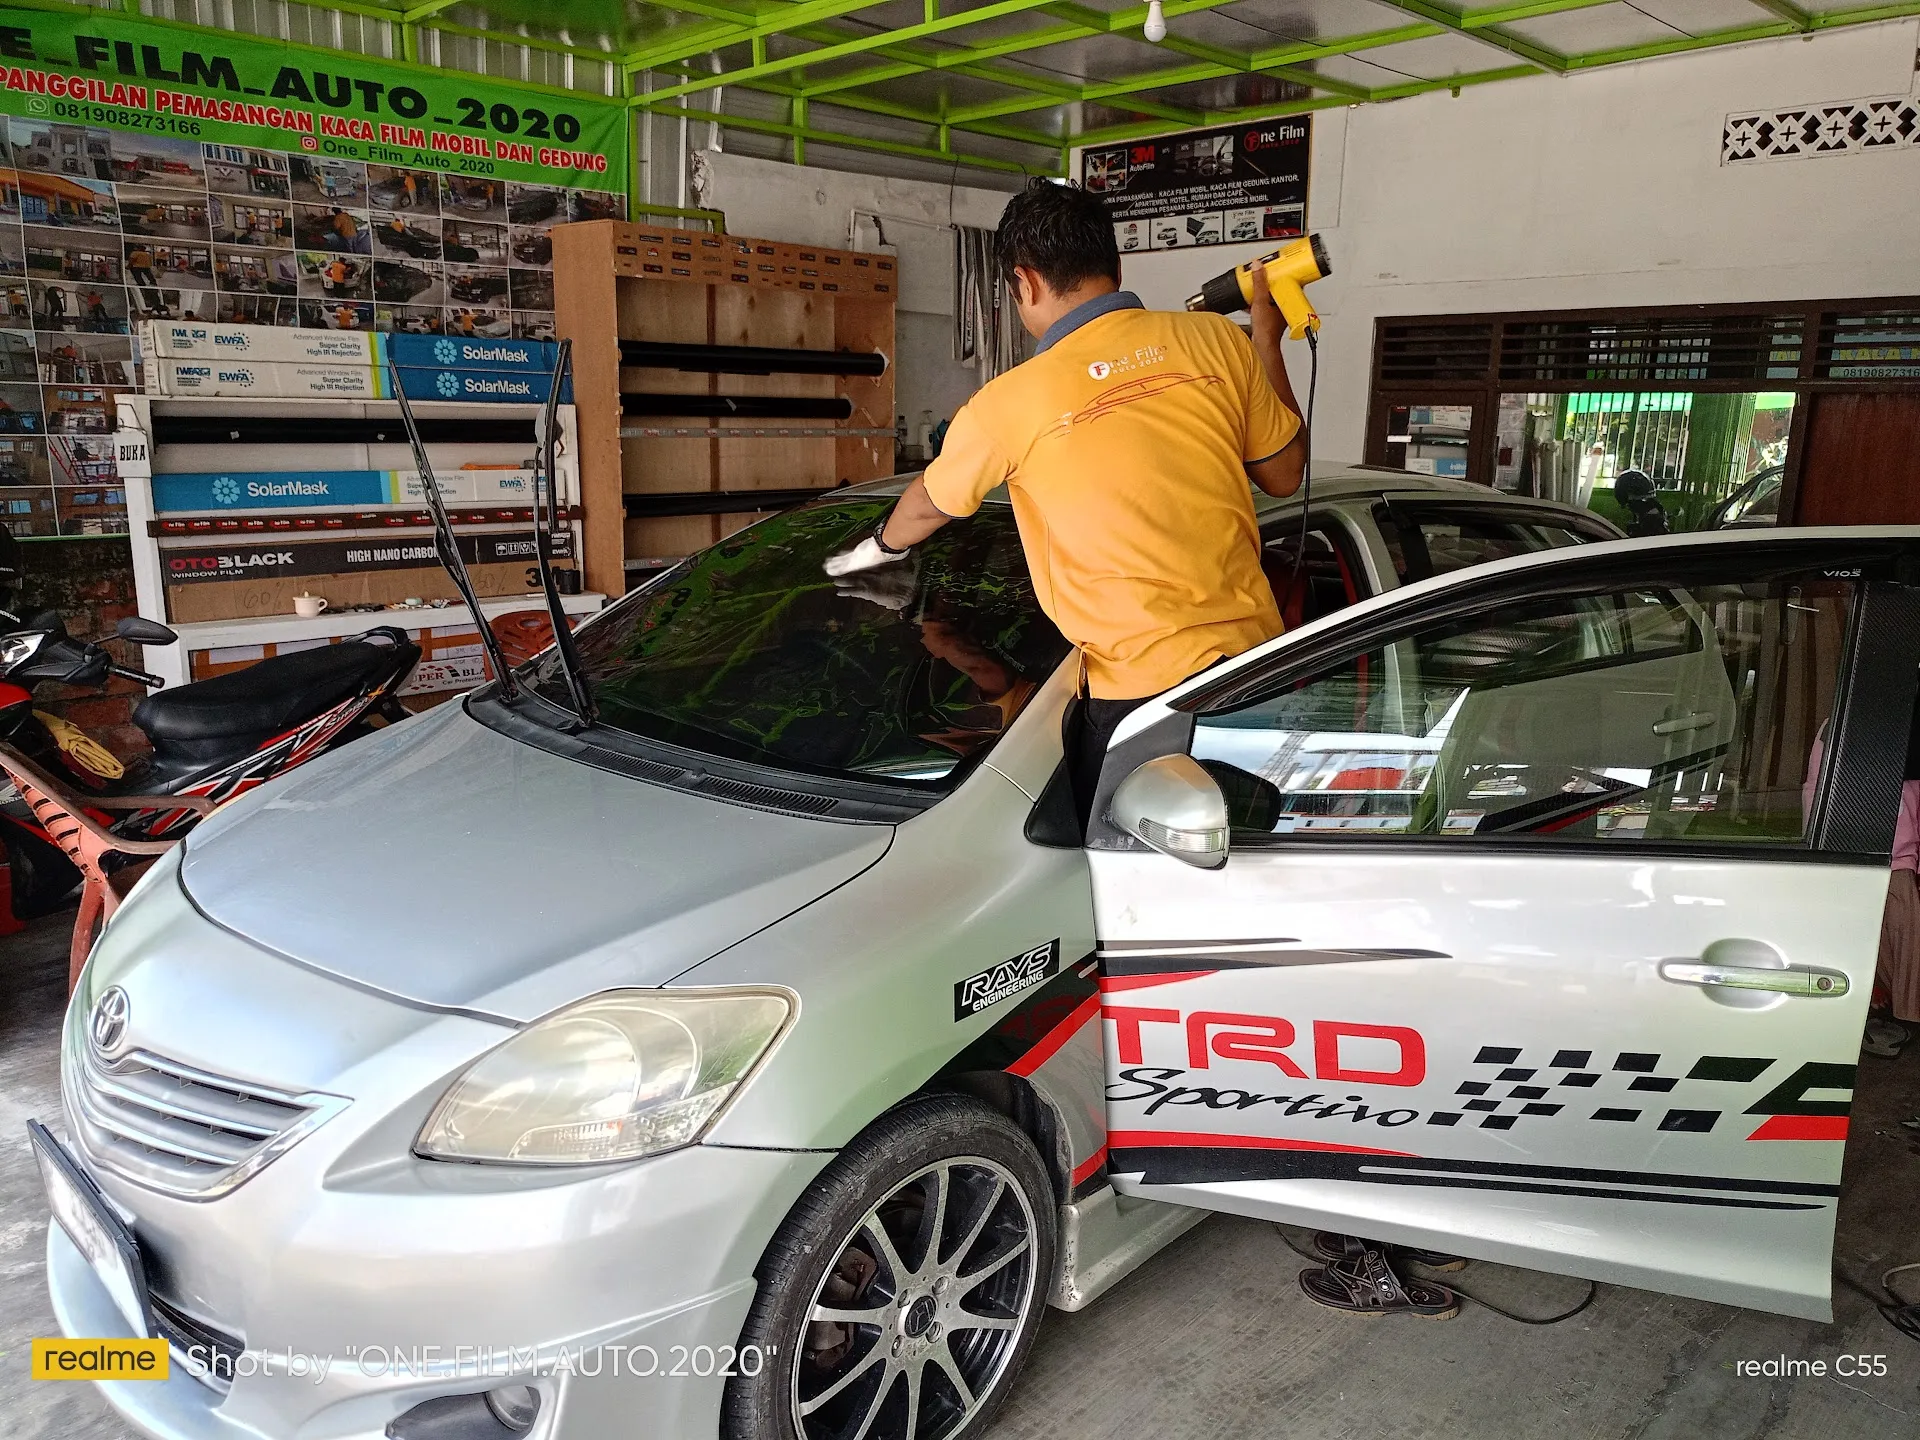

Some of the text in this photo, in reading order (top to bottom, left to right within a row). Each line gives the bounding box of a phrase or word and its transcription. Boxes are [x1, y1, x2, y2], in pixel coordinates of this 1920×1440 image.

[54, 101, 201, 136] 081908273166
[154, 89, 315, 136] PEMASANGAN
[319, 114, 375, 141] KACA
[380, 124, 427, 149] FILM
[431, 131, 491, 158] MOBIL
[495, 141, 533, 164] DAN
[539, 147, 608, 174] GEDUNG
[1279, 125, 1305, 141] Film
[322, 139, 495, 174] One_Film_Auto_2020
[1130, 145, 1155, 164] 3M
[1158, 190, 1175, 198] KACA
[1210, 182, 1227, 191] KACA
[1186, 201, 1210, 210] SEGALA
[306, 348, 322, 357] High
[331, 349, 362, 357] Rejection
[319, 342, 361, 351] Super Clarity
[463, 345, 529, 363] SolarMask
[310, 383, 326, 392] High
[335, 384, 365, 392] Rejection
[322, 376, 364, 385] Super Clarity
[464, 378, 531, 395] SolarMask
[119, 444, 146, 461] BUKA
[247, 480, 329, 497] SolarMask
[169, 551, 295, 571] OTOBLACK
[346, 549, 372, 563] HIGH
[373, 548, 401, 562] NANO
[171, 569, 244, 579] WINDOW FILM
[961, 942, 1052, 1007] RAYS
[972, 969, 1044, 1012] ENGINEERING
[1100, 1005, 1426, 1087] TRD
[1105, 1067, 1419, 1127] Sportivo
